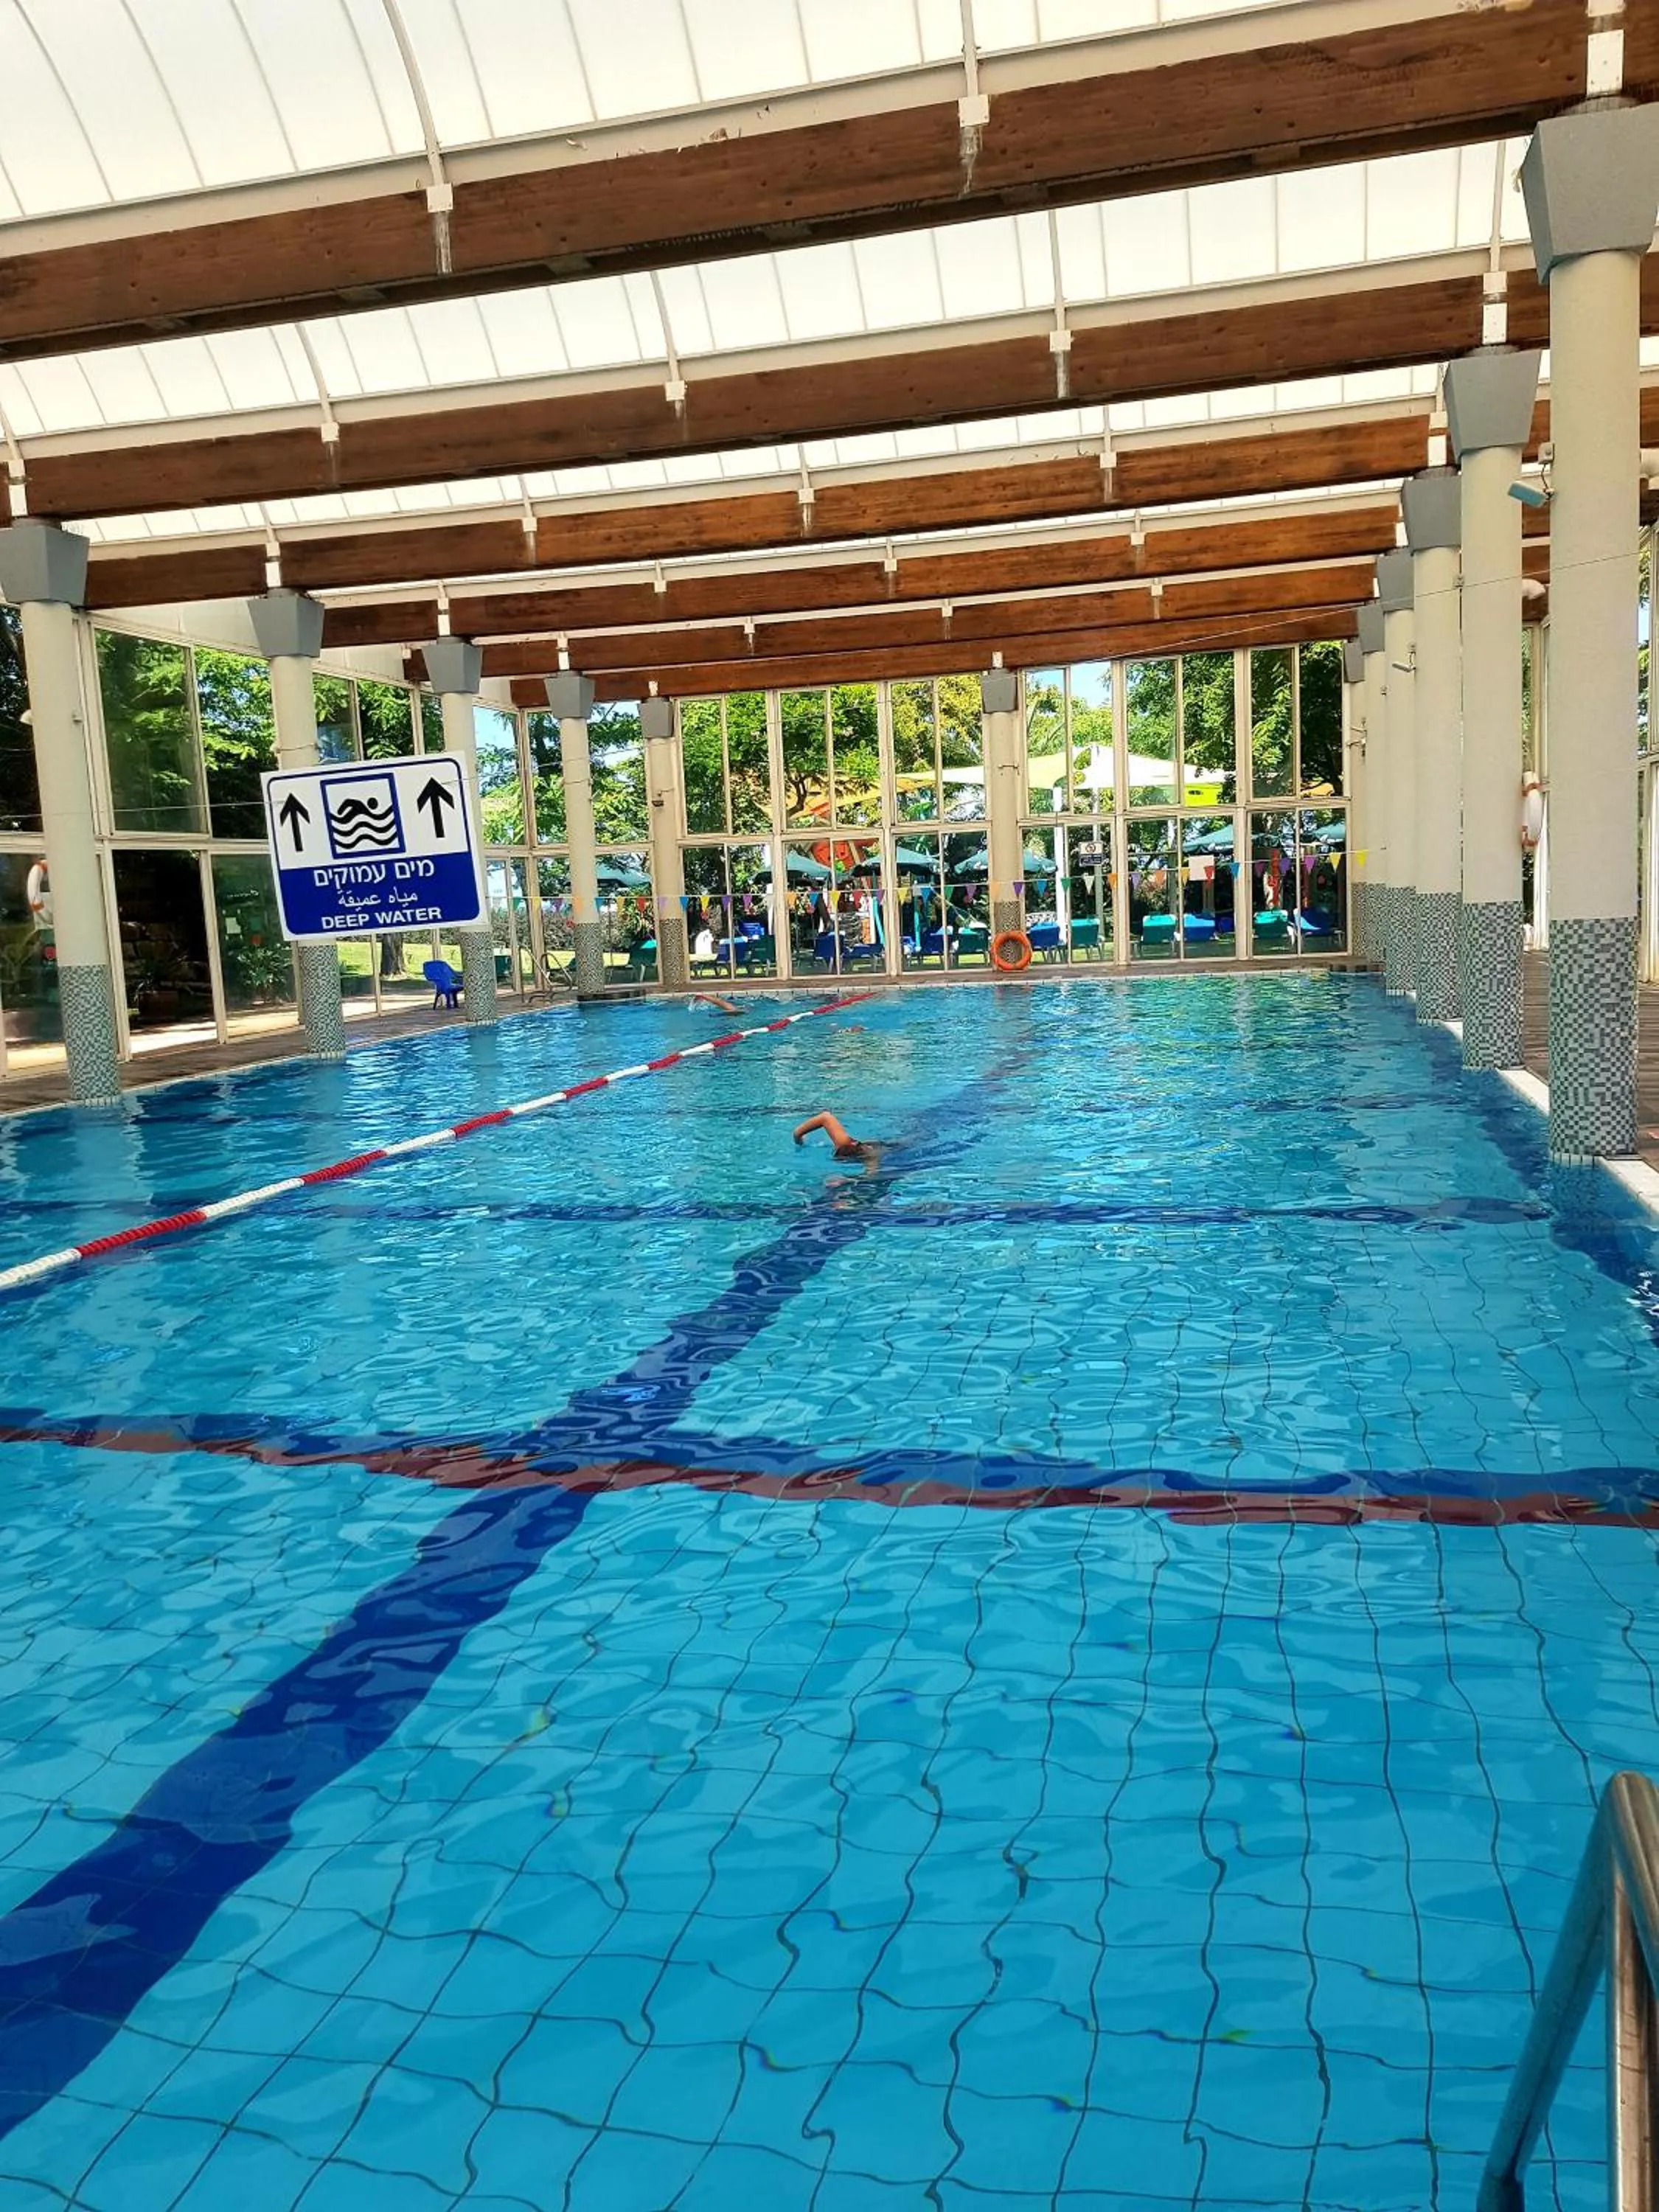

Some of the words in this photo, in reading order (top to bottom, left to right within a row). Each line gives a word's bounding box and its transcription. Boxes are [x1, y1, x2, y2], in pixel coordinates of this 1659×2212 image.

[313, 863, 386, 889] עמוקים
[394, 859, 434, 879] מים
[338, 890, 381, 911] عميقة
[389, 886, 418, 908] مياه
[321, 913, 369, 930] DEEP
[375, 906, 442, 925] WATER
